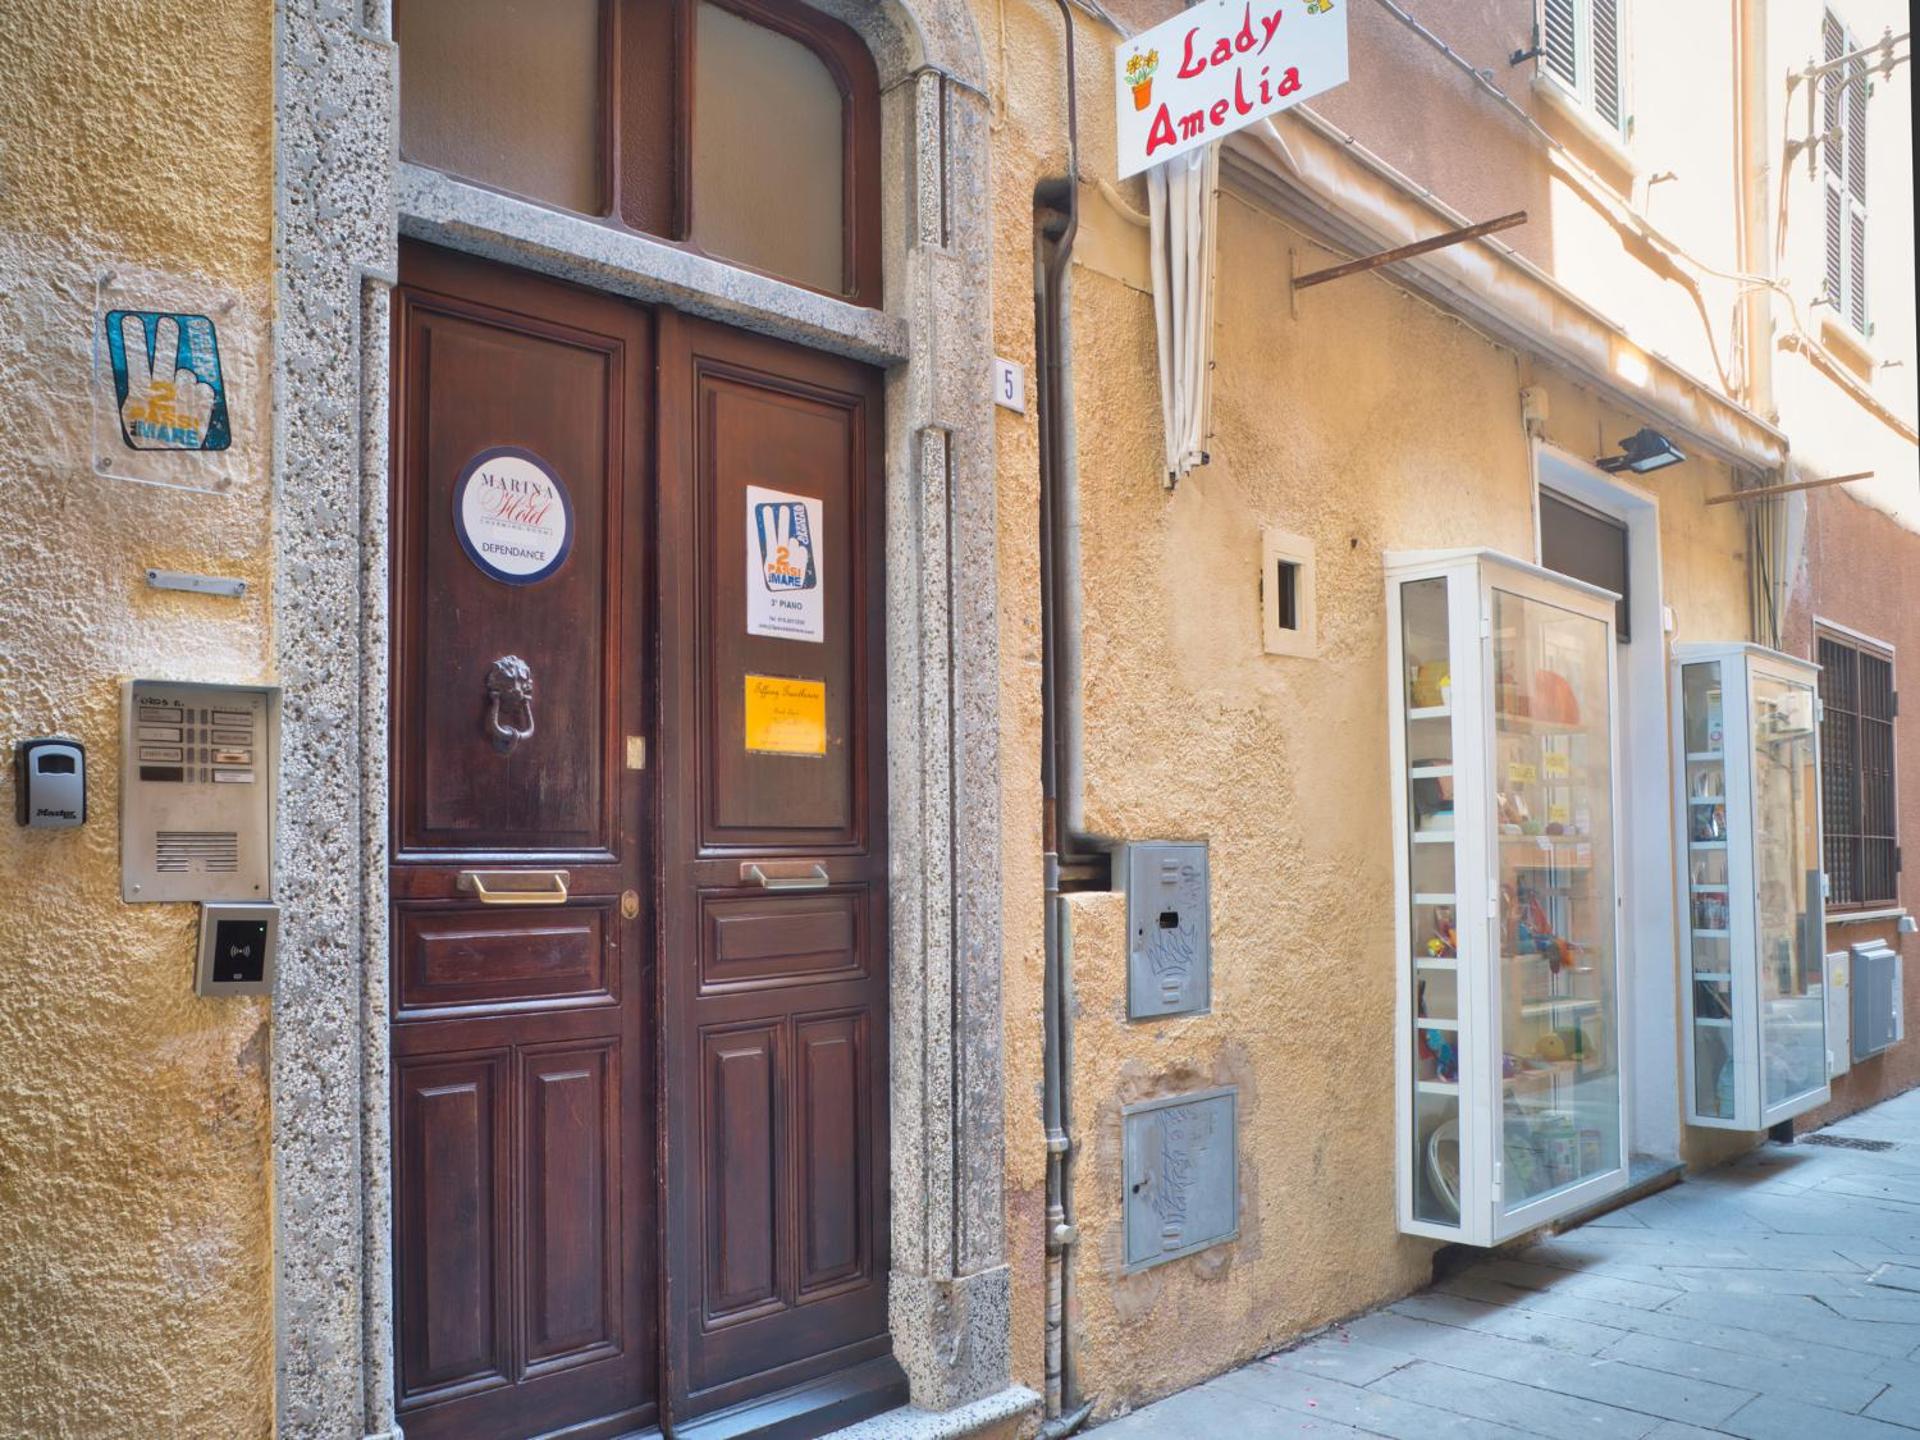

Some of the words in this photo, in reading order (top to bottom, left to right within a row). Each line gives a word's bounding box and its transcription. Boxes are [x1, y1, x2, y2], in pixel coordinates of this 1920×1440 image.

[1177, 2, 1282, 78] Lady
[1146, 66, 1303, 156] Amelia
[149, 381, 176, 410] 2
[1005, 369, 1013, 400] 5
[481, 472, 553, 499] MARINA
[482, 542, 546, 561] DEPENDANCE
[776, 546, 789, 565] 2
[768, 563, 802, 577] PASSI
[771, 573, 801, 587] MARE
[779, 599, 803, 610] PIANO
